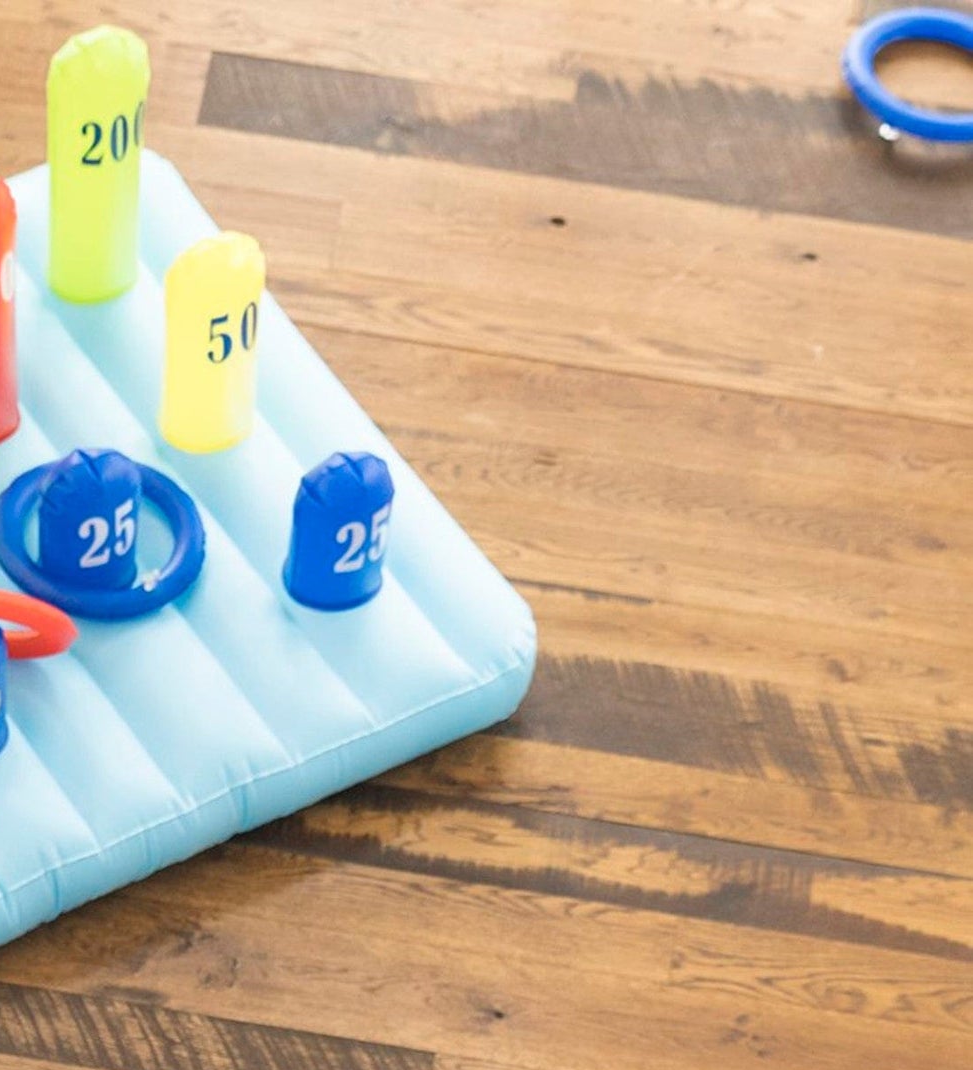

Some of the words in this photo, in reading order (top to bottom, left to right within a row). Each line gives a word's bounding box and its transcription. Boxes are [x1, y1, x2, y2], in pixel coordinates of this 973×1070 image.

[207, 302, 257, 364] 50
[78, 498, 135, 568] 25
[332, 502, 390, 573] 25
